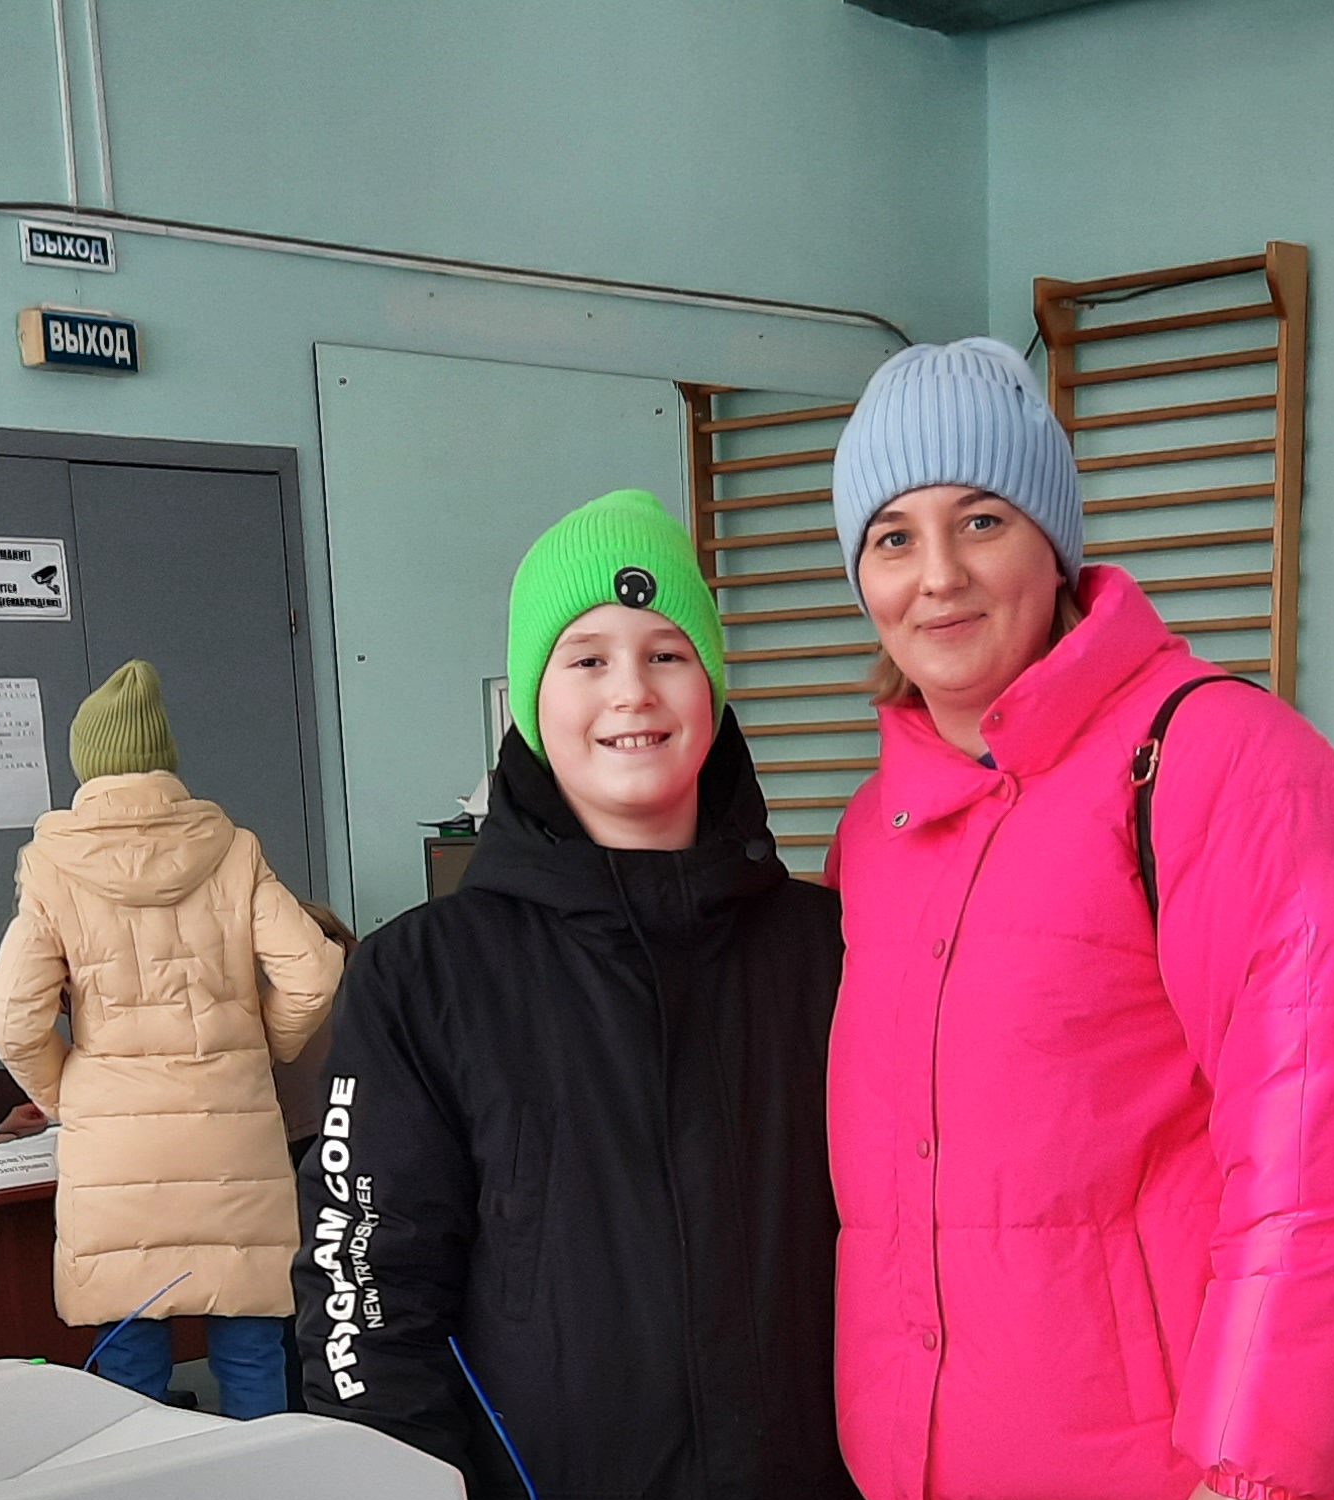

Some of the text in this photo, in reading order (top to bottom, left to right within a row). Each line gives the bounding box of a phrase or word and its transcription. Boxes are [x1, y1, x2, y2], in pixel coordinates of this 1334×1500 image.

[31, 231, 105, 263] ВЫХОД
[49, 320, 131, 365] ВЫХОД
[321, 1077, 356, 1203] CODE
[362, 1288, 385, 1329] NEW
